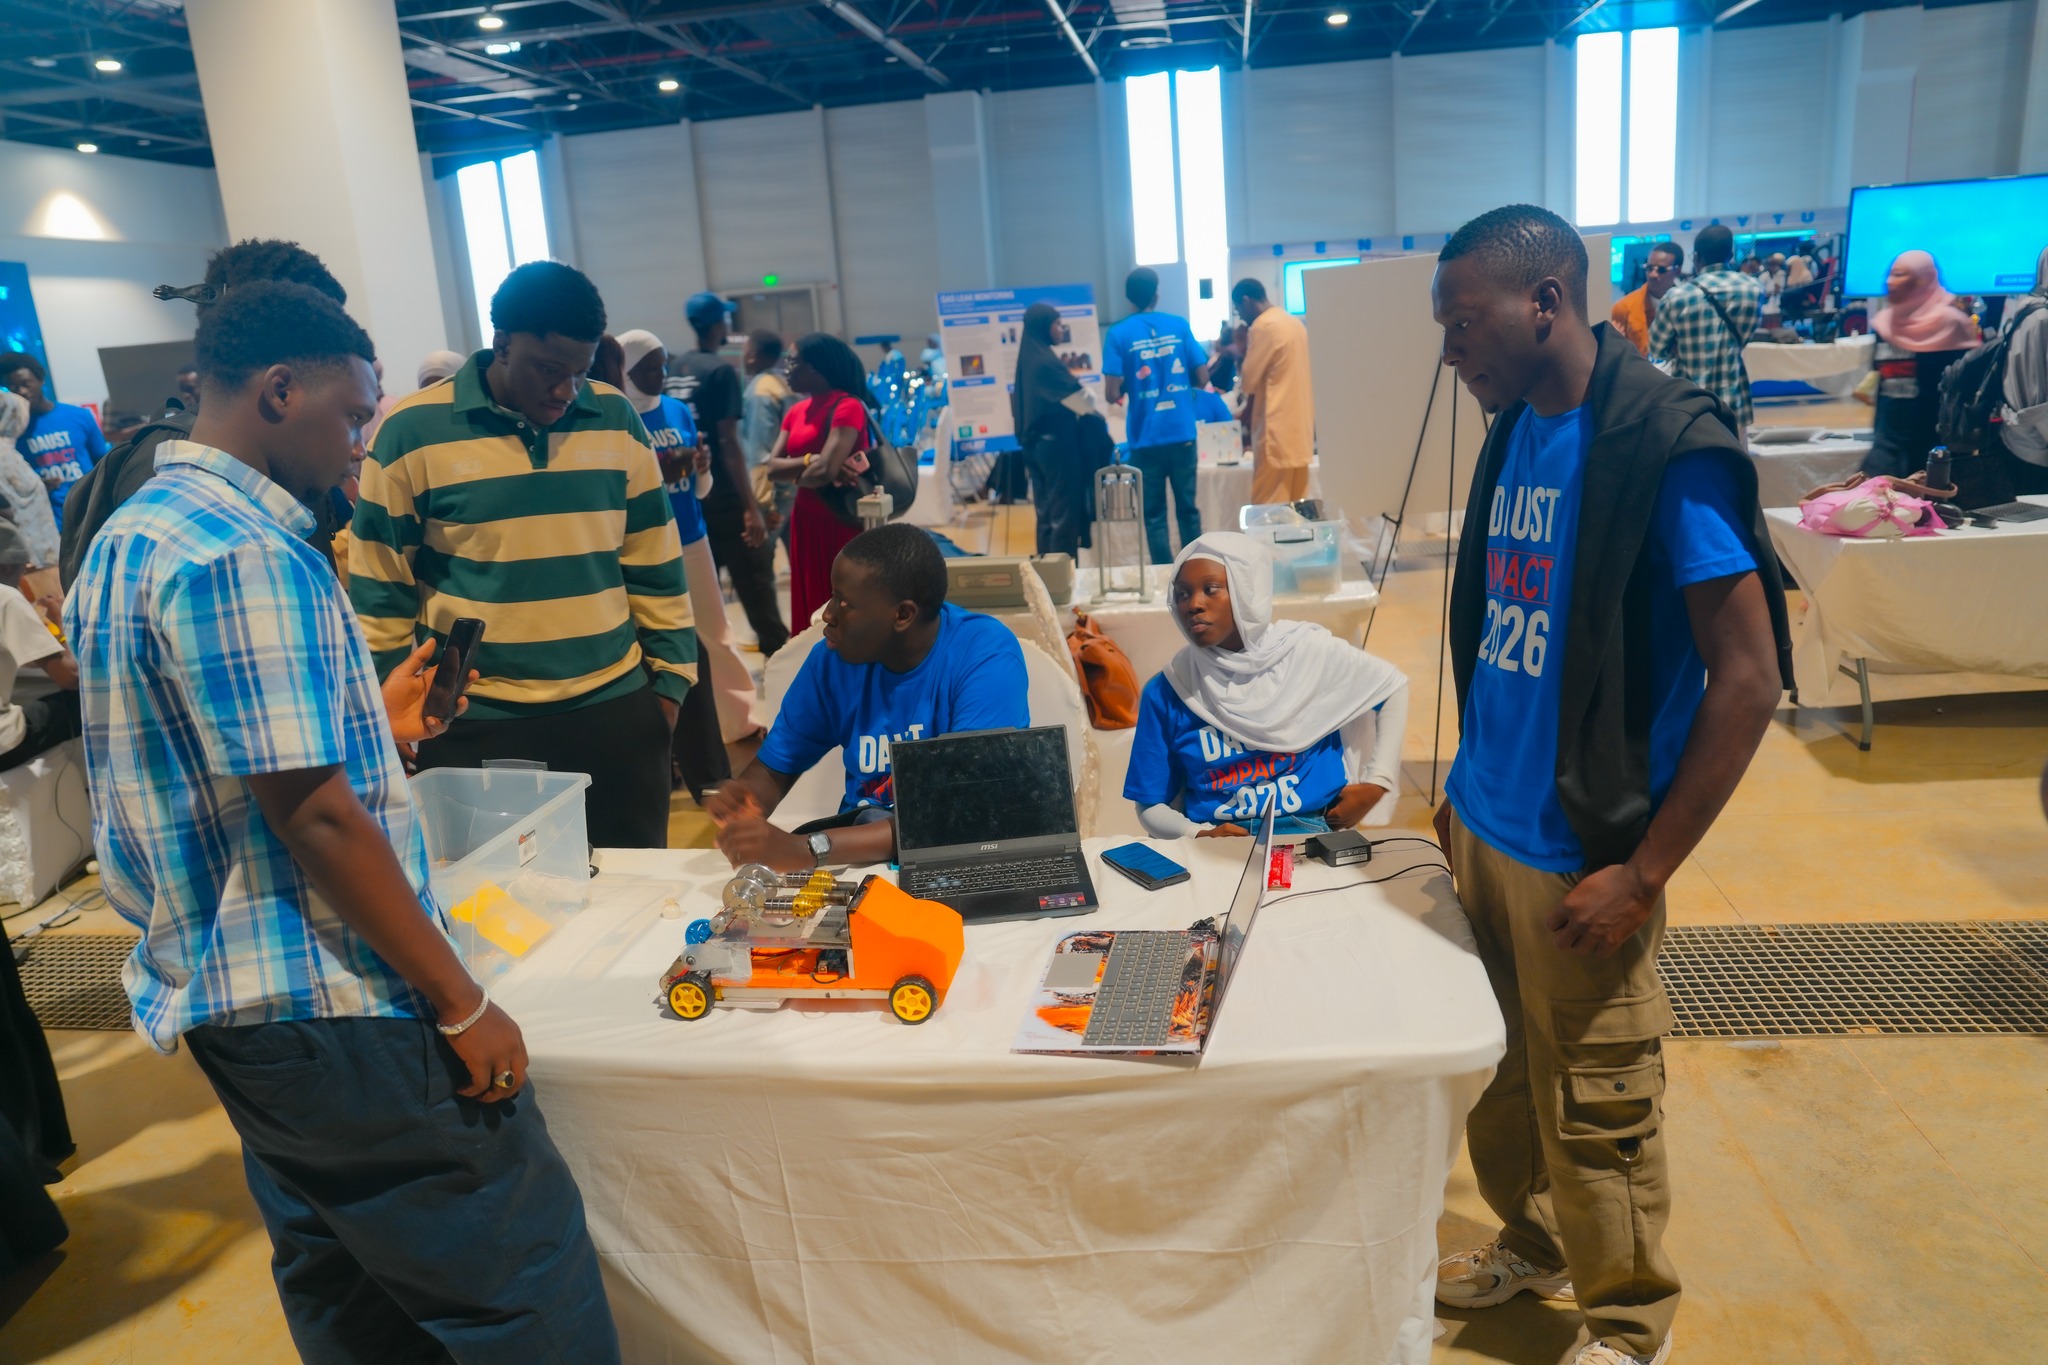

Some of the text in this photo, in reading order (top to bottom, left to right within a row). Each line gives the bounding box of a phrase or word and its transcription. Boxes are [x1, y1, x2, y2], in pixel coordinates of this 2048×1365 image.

[27, 431, 71, 454] DAUST
[649, 427, 684, 449] AUST
[1488, 485, 1562, 543] DUST
[1478, 599, 1550, 678] 2026
[859, 723, 925, 774] DAT
[1213, 774, 1303, 821] 2026
